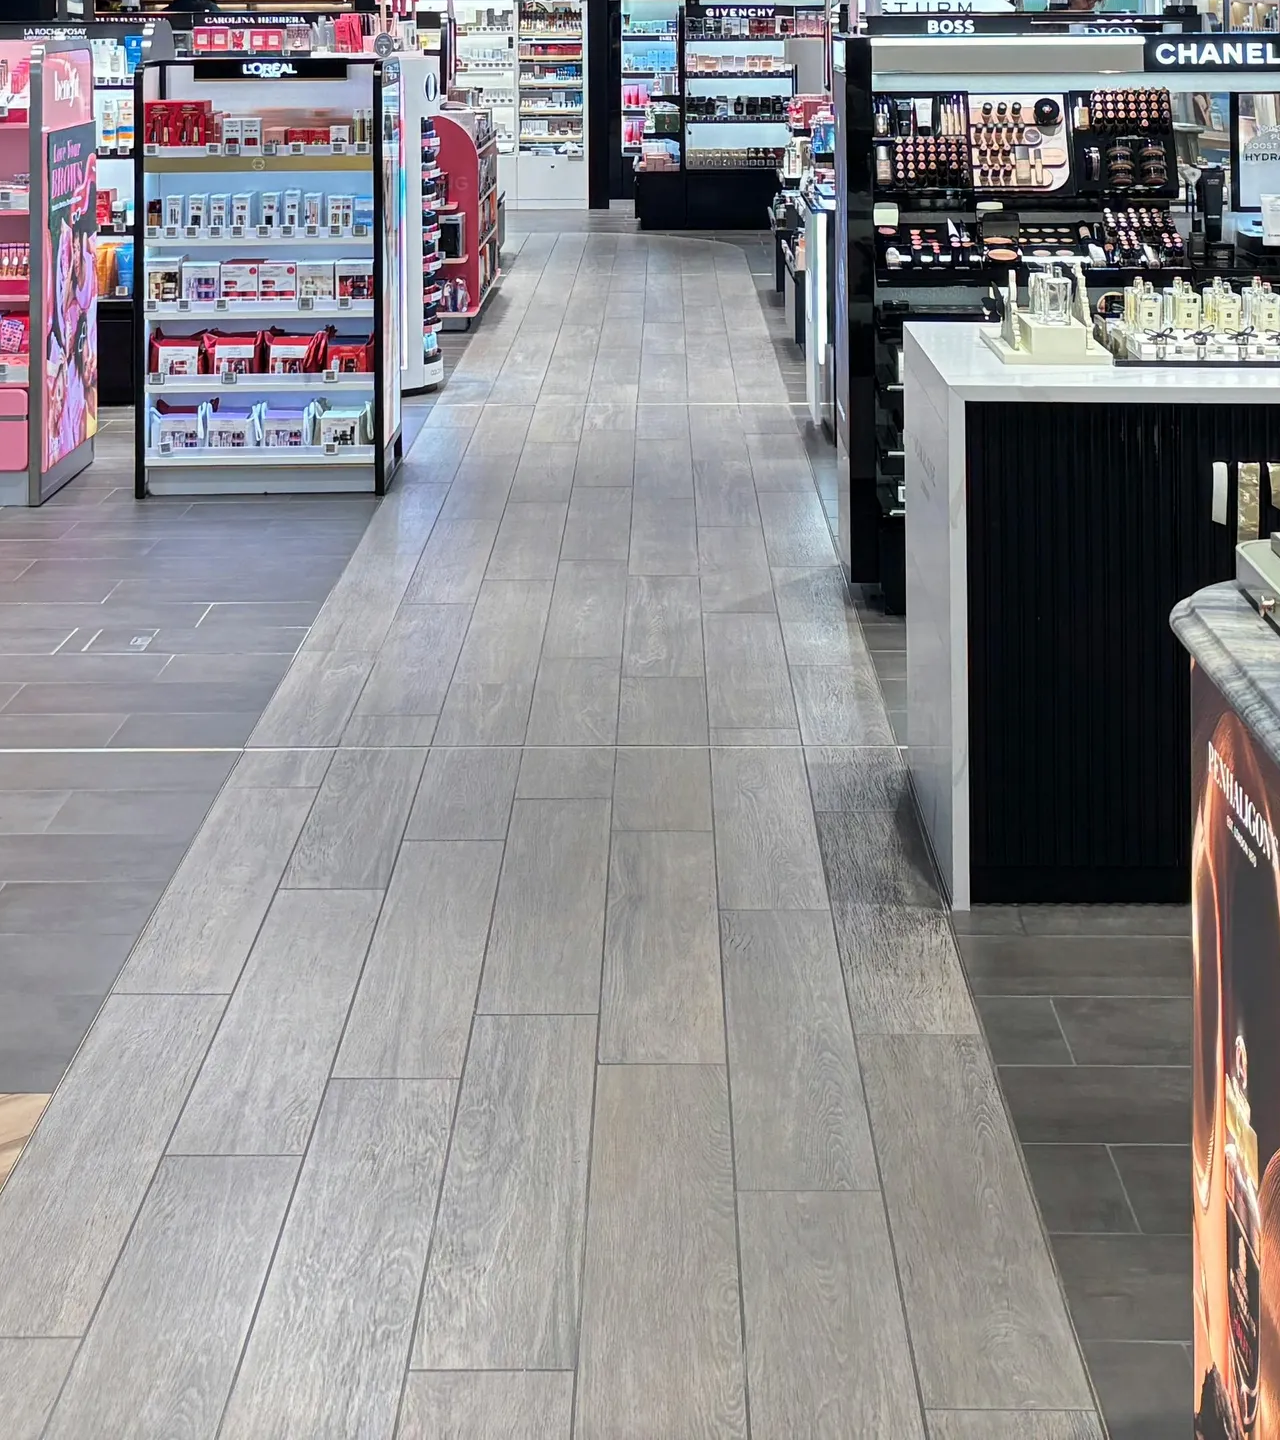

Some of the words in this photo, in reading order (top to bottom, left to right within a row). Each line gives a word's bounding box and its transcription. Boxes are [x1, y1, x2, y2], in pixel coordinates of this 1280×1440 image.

[705, 8, 775, 17] GIVENCHY
[204, 16, 256, 24] CAROLINA
[258, 16, 306, 24] HERRERA
[927, 19, 975, 34] BOSS
[23, 28, 34, 36] LA
[51, 161, 83, 199] BROWS
